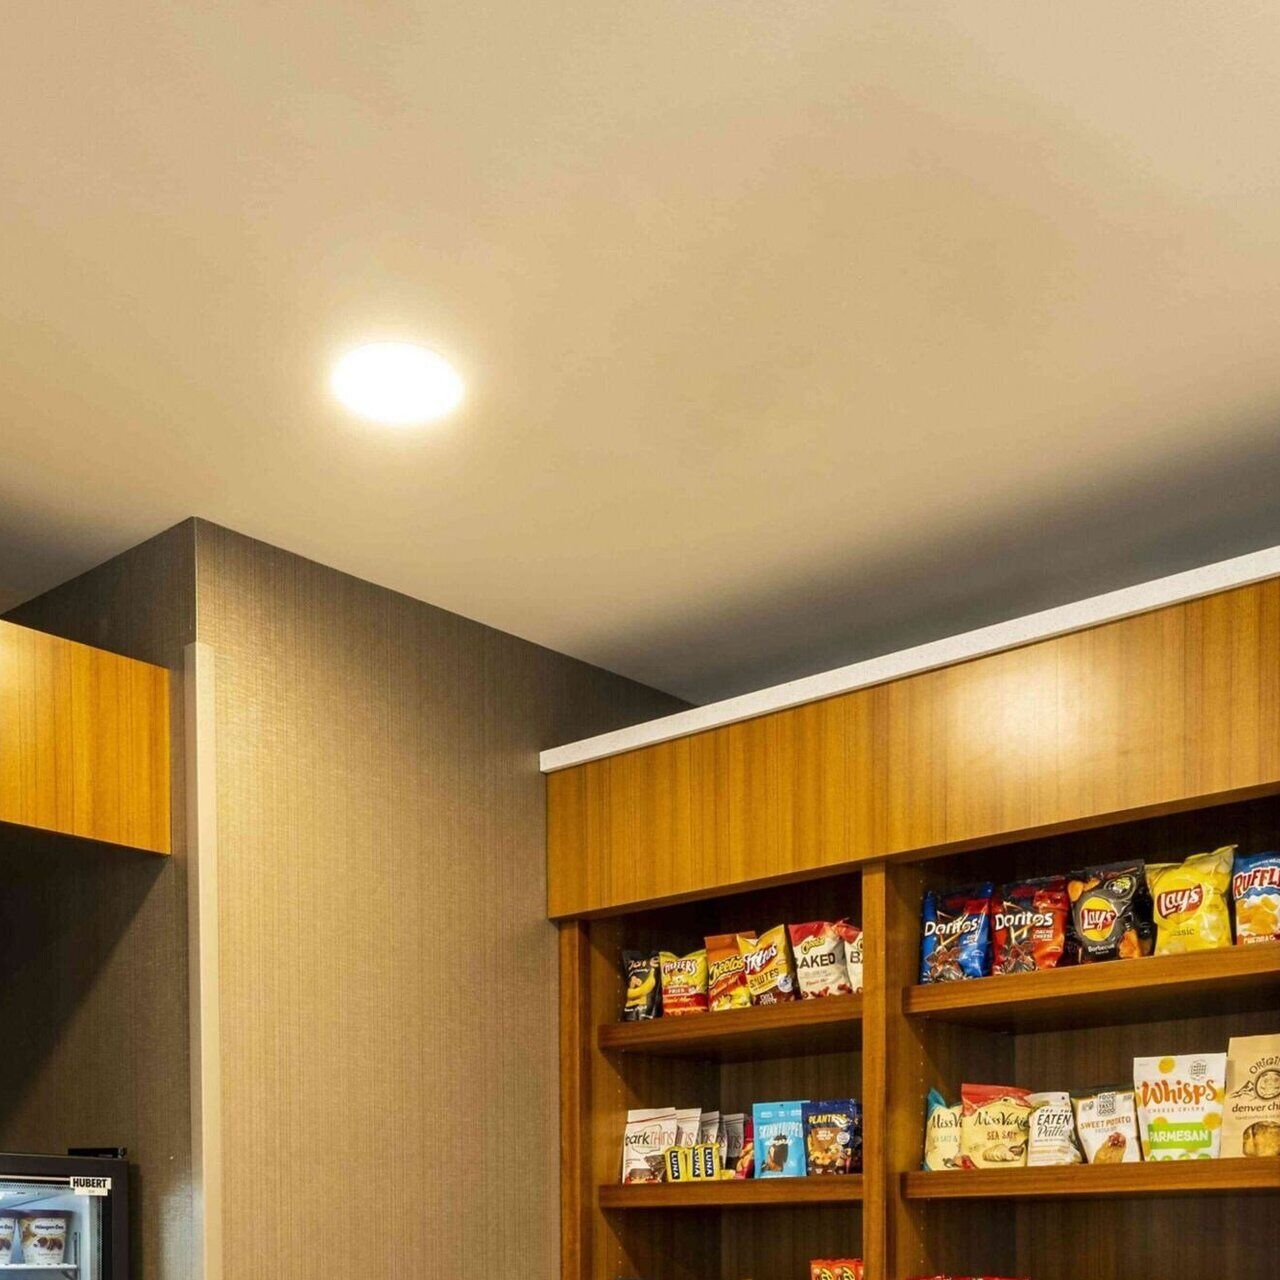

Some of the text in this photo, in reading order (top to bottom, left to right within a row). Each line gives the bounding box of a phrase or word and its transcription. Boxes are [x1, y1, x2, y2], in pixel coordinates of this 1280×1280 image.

[1160, 886, 1202, 916] Lay's
[924, 918, 978, 936] Doritos
[995, 911, 1053, 931] Doritos
[1084, 909, 1116, 931] Lay's
[797, 953, 835, 969] AKED
[1142, 1079, 1218, 1107] Whisps
[1232, 1103, 1264, 1113] denver
[808, 1114, 847, 1125] PLANT
[931, 1114, 952, 1129] Miss
[974, 1111, 1000, 1127] Miss
[1001, 1112, 1031, 1131] Vickie
[1037, 1114, 1072, 1126] EATEN
[1081, 1116, 1131, 1130] SWEET POTATO
[987, 1131, 1017, 1141] SEA SALT
[1150, 1130, 1209, 1142] PARMESAN
[671, 1151, 679, 1179] LUNA
[705, 1148, 714, 1177] LUNA
[73, 1177, 108, 1189] HUBERT
